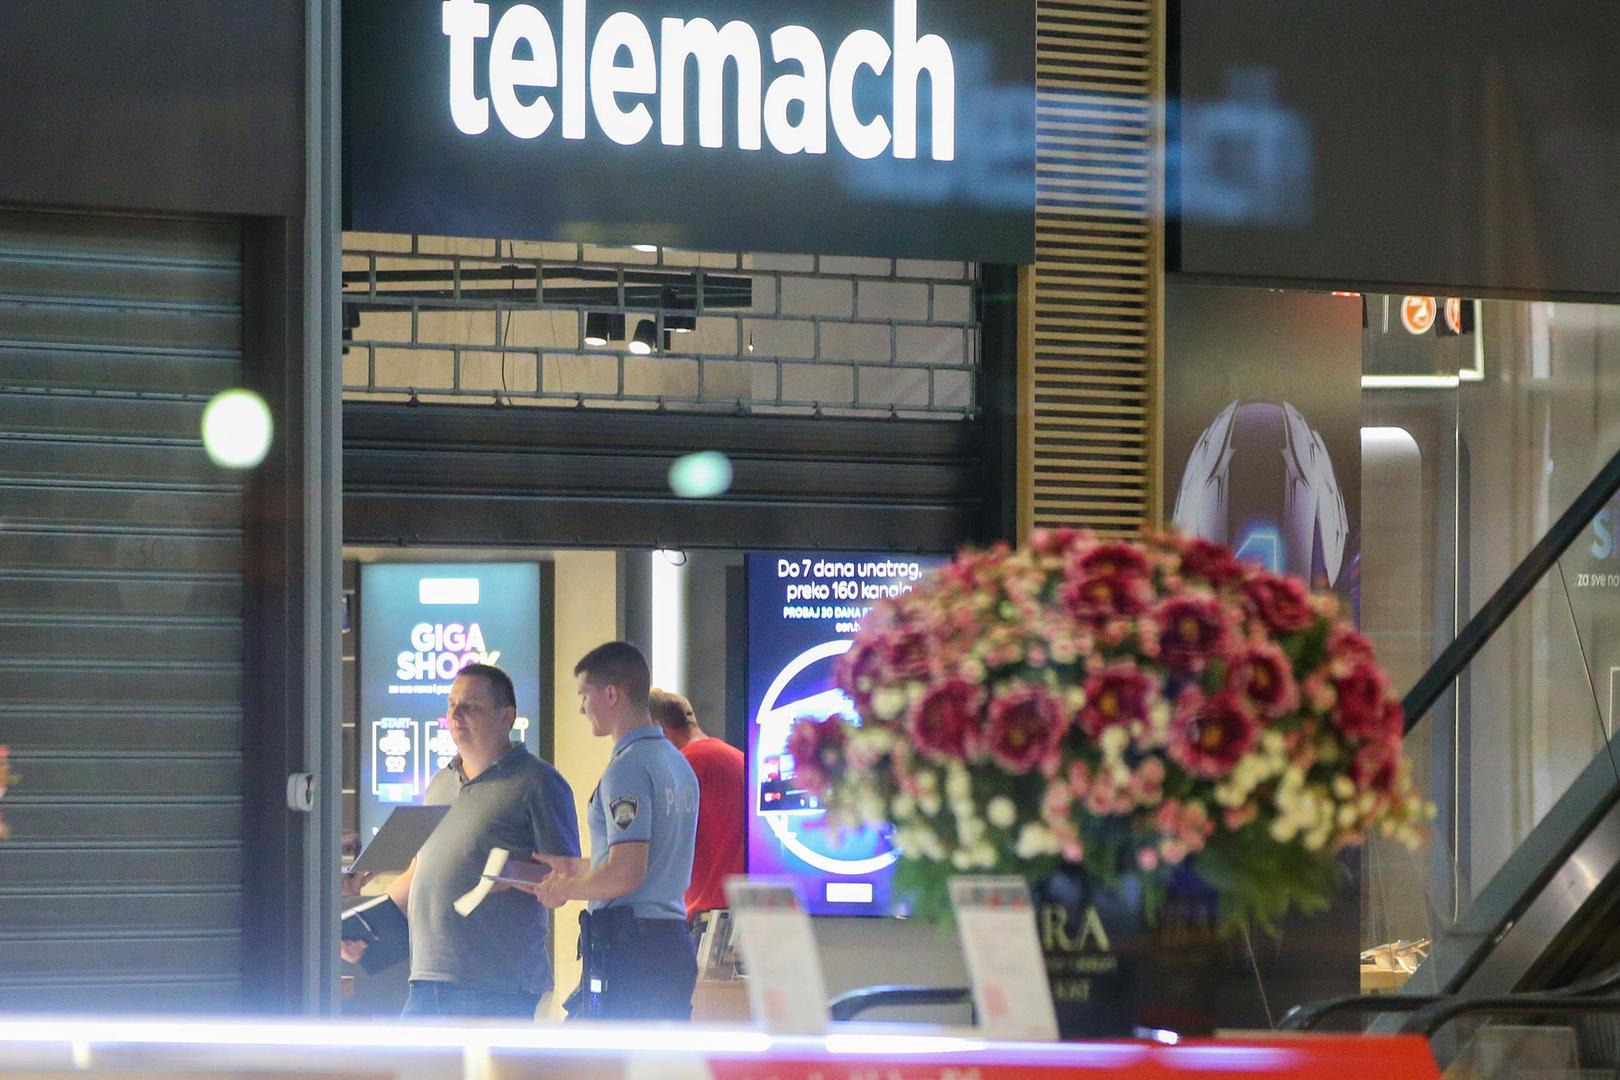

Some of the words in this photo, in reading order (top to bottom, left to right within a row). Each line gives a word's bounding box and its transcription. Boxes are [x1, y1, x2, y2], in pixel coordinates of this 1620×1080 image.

[442, 0, 955, 161] telemach
[777, 559, 800, 578] Do
[802, 559, 812, 577] 7
[813, 559, 855, 578] dana
[857, 560, 923, 581] unatrag,
[786, 581, 830, 603] preko
[831, 581, 859, 600] 160
[834, 606, 861, 619] DANA
[411, 622, 486, 652] GIGA
[380, 717, 412, 729] START
[1042, 903, 1112, 952] RA
